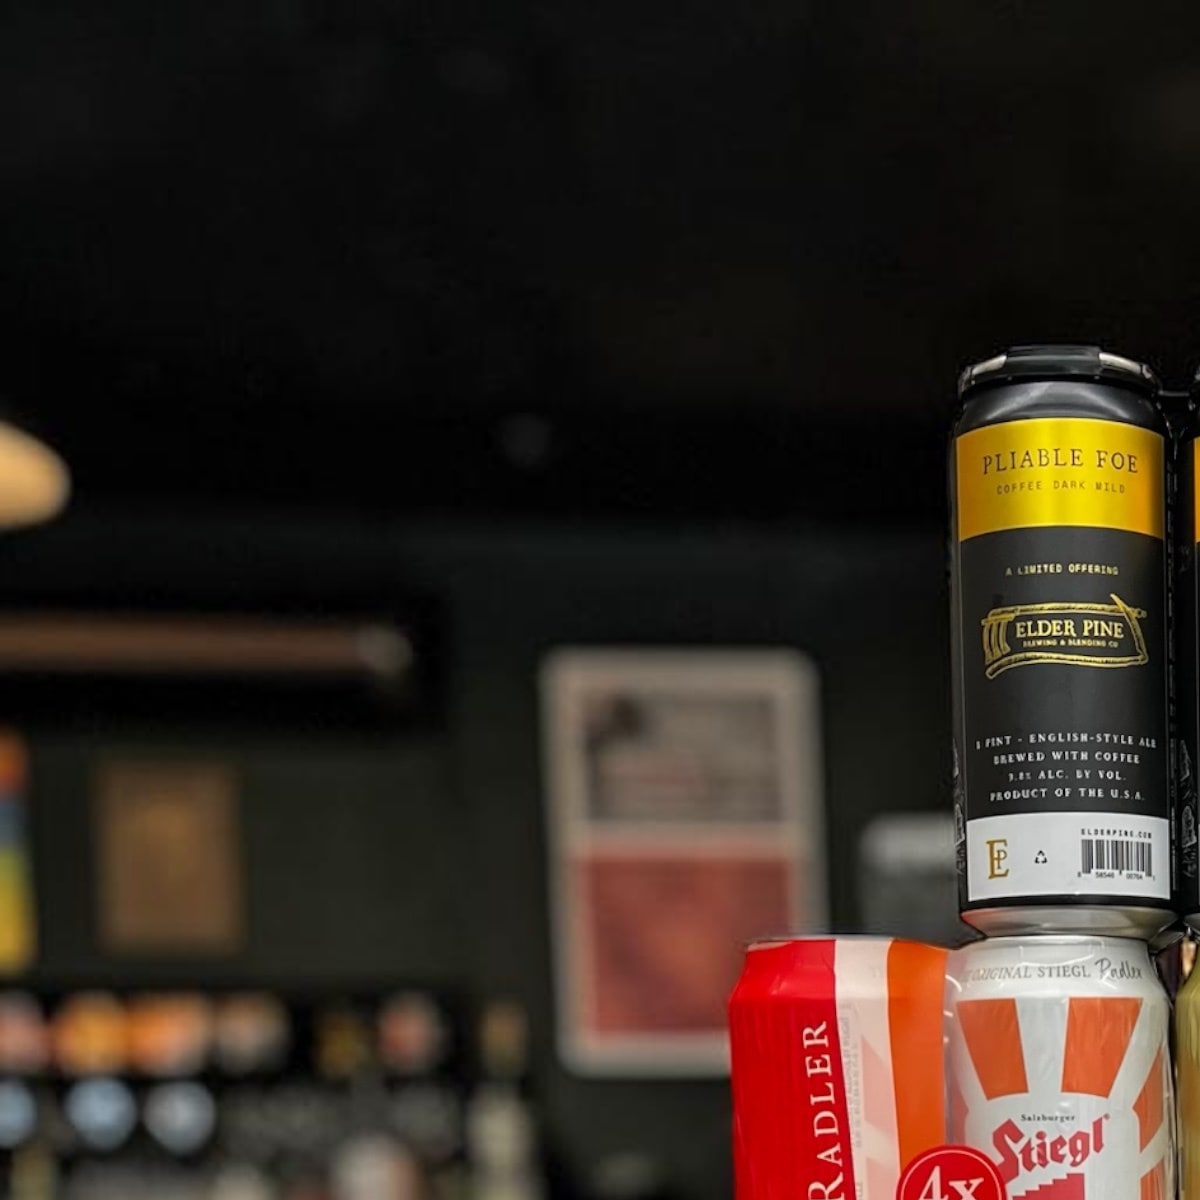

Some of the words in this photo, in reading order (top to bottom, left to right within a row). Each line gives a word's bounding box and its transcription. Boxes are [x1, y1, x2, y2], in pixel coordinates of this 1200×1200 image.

[983, 448, 1084, 475] PLIABLE
[1096, 450, 1139, 473] FOE
[996, 480, 1042, 495] COFFEE
[1053, 480, 1086, 490] DARK
[1095, 482, 1126, 494] MILD
[1005, 567, 1013, 576] A
[1017, 563, 1063, 575] LIMITED
[1068, 563, 1119, 576] OFFERING
[1015, 619, 1076, 638] ELDER
[1083, 619, 1124, 638] PINE
[1022, 639, 1058, 648] BREWING
[1068, 638, 1106, 648] BLENDING
[985, 735, 1013, 748] PINT
[1029, 733, 1134, 746] ENGLISH-STYLE
[1138, 737, 1157, 748] ALE
[993, 751, 1045, 765] BREWED
[1052, 750, 1089, 761] WITH
[1095, 751, 1141, 764] COFFEE
[1038, 769, 1069, 780] ALC.
[1076, 769, 1091, 779] BY
[1098, 769, 1126, 781] VOL.
[990, 788, 1047, 801] PRODUCT
[1055, 787, 1072, 798] OF
[1079, 787, 1105, 798] THE
[1037, 965, 1091, 978] STIEGL
[1021, 1114, 1075, 1122] Salzburger
